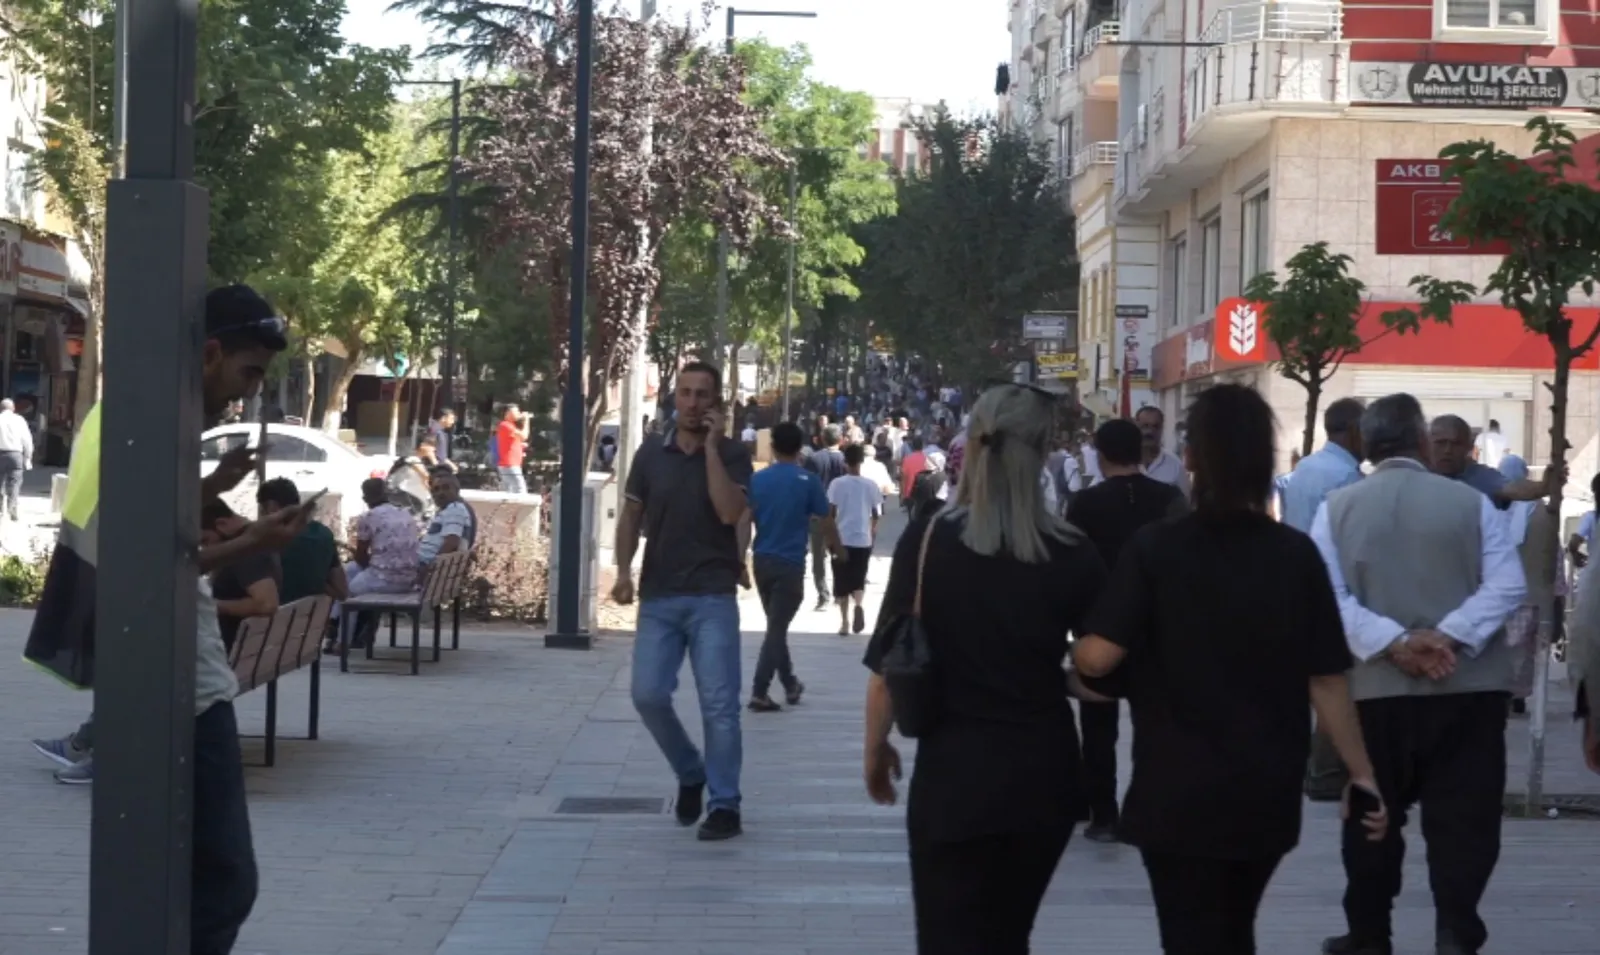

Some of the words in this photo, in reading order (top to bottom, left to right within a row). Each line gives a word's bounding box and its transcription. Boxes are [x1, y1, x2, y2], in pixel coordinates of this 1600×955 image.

[1424, 64, 1553, 84] AVUKAT
[1413, 84, 1466, 96] Mehmet
[1469, 84, 1499, 99] Ulaş
